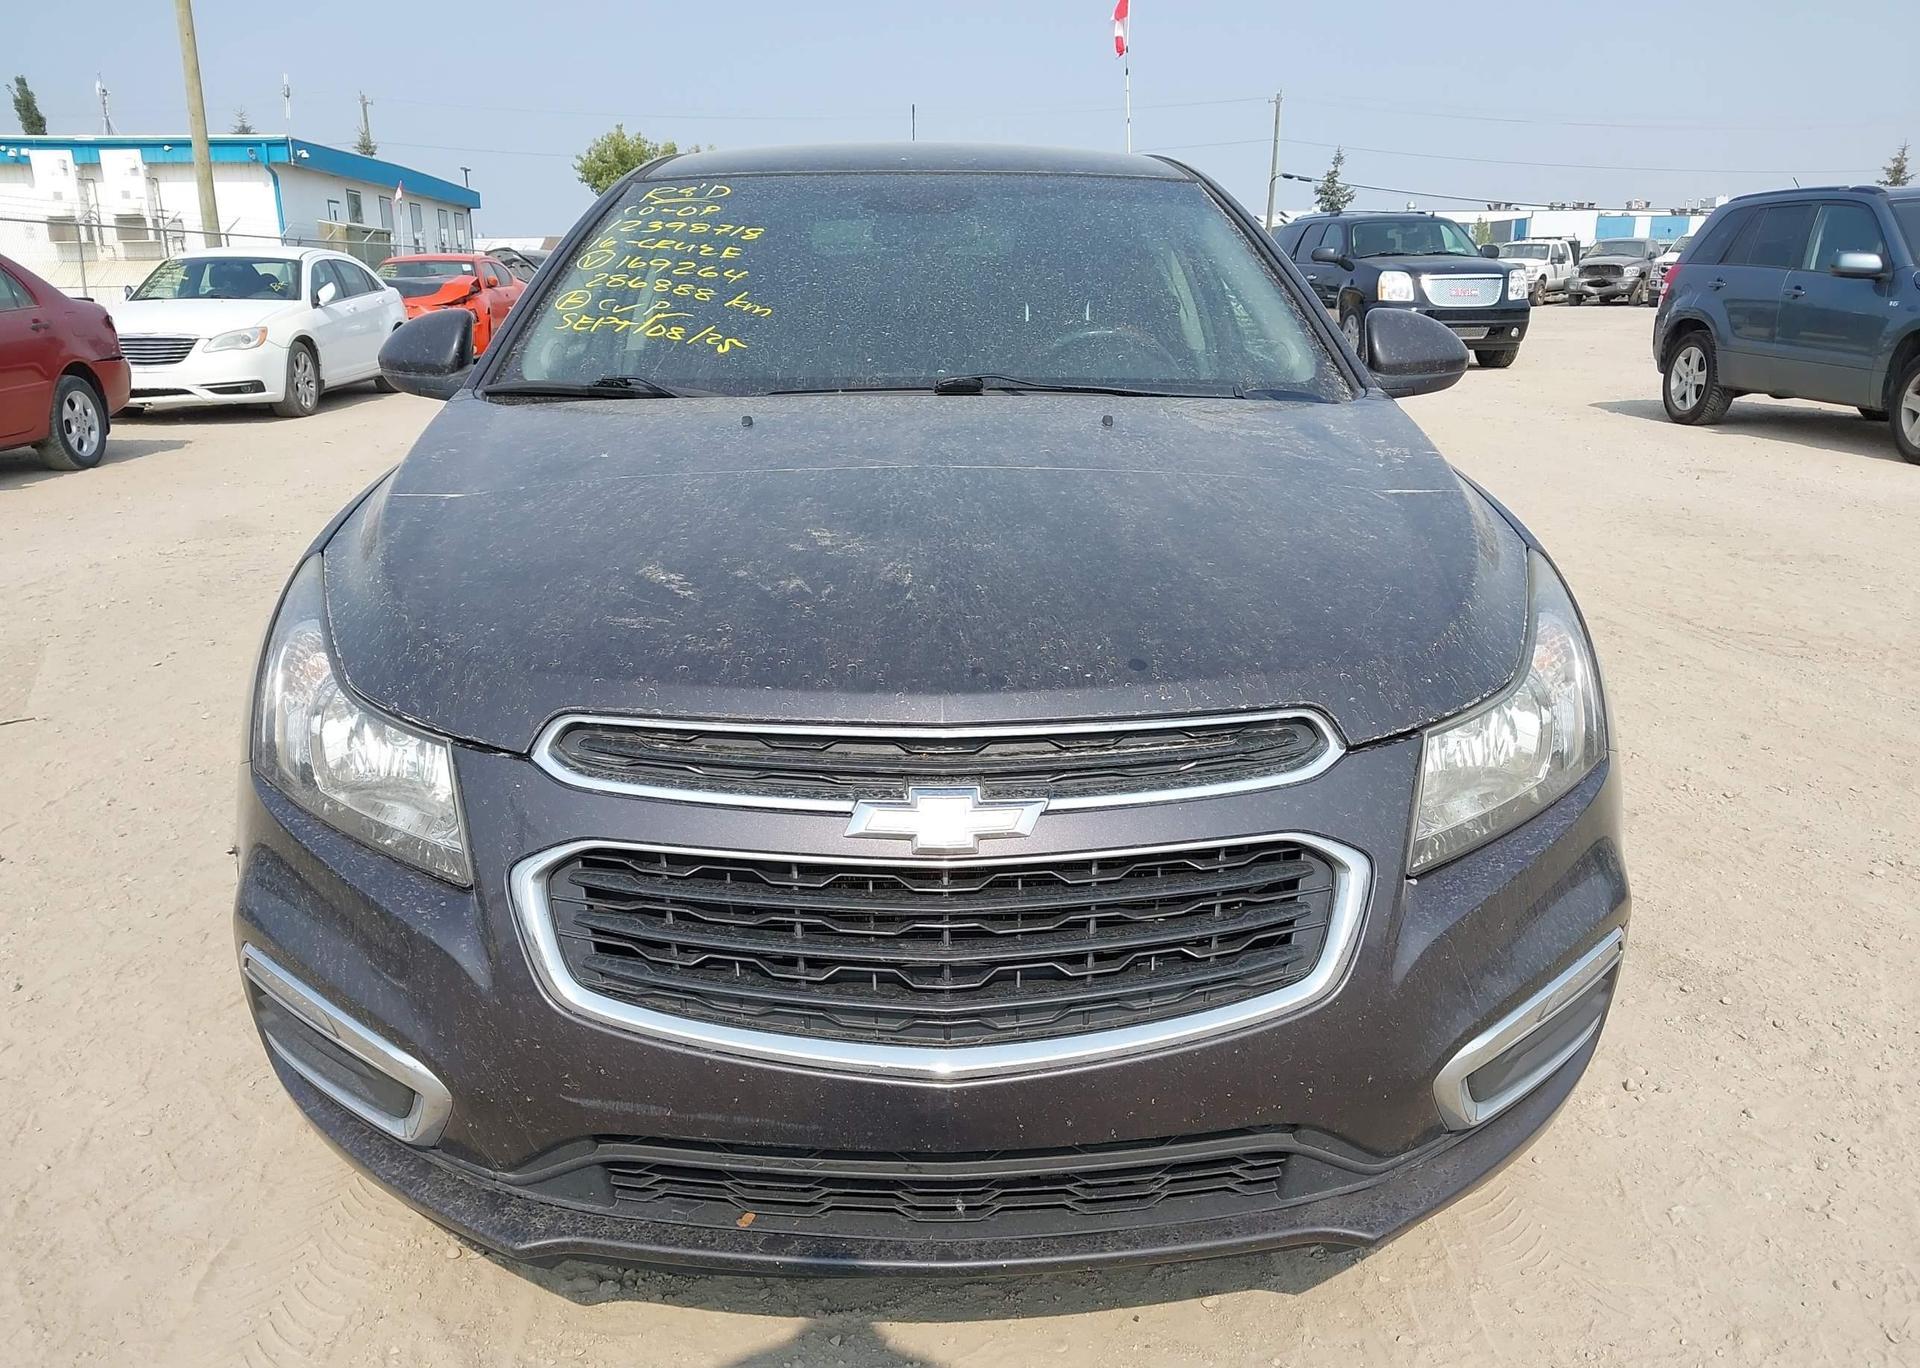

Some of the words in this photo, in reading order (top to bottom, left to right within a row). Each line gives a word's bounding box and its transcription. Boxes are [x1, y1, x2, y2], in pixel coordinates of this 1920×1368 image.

[602, 219, 766, 240] 12398718
[615, 255, 749, 284] 169264
[585, 273, 717, 301] 286888
